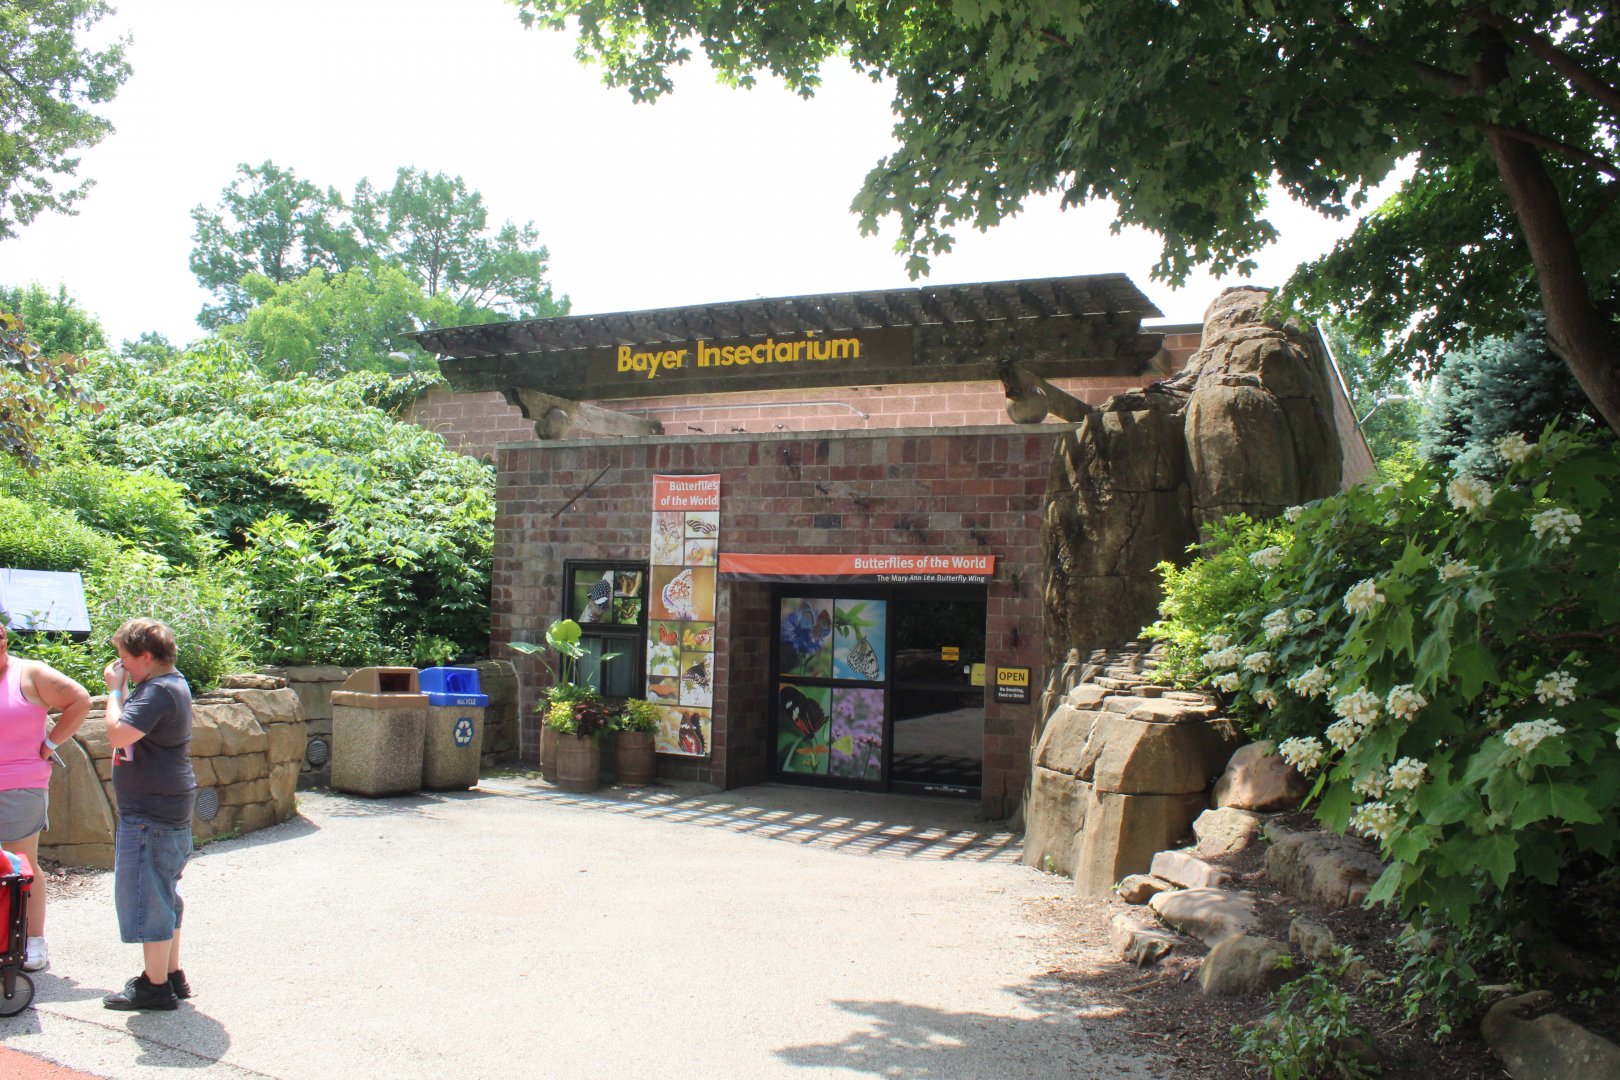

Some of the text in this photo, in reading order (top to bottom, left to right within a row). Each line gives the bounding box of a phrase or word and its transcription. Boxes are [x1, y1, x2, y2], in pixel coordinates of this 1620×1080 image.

[617, 331, 860, 378] Bayer Insectarium
[670, 481, 719, 491] Butterflies
[661, 494, 718, 506] of the World
[854, 556, 987, 569] Butterflies of the World
[877, 574, 889, 582] The
[891, 574, 908, 583] Mary
[937, 574, 966, 583] Butterfly
[968, 575, 985, 583] Wing
[999, 671, 1025, 681] OPEN
